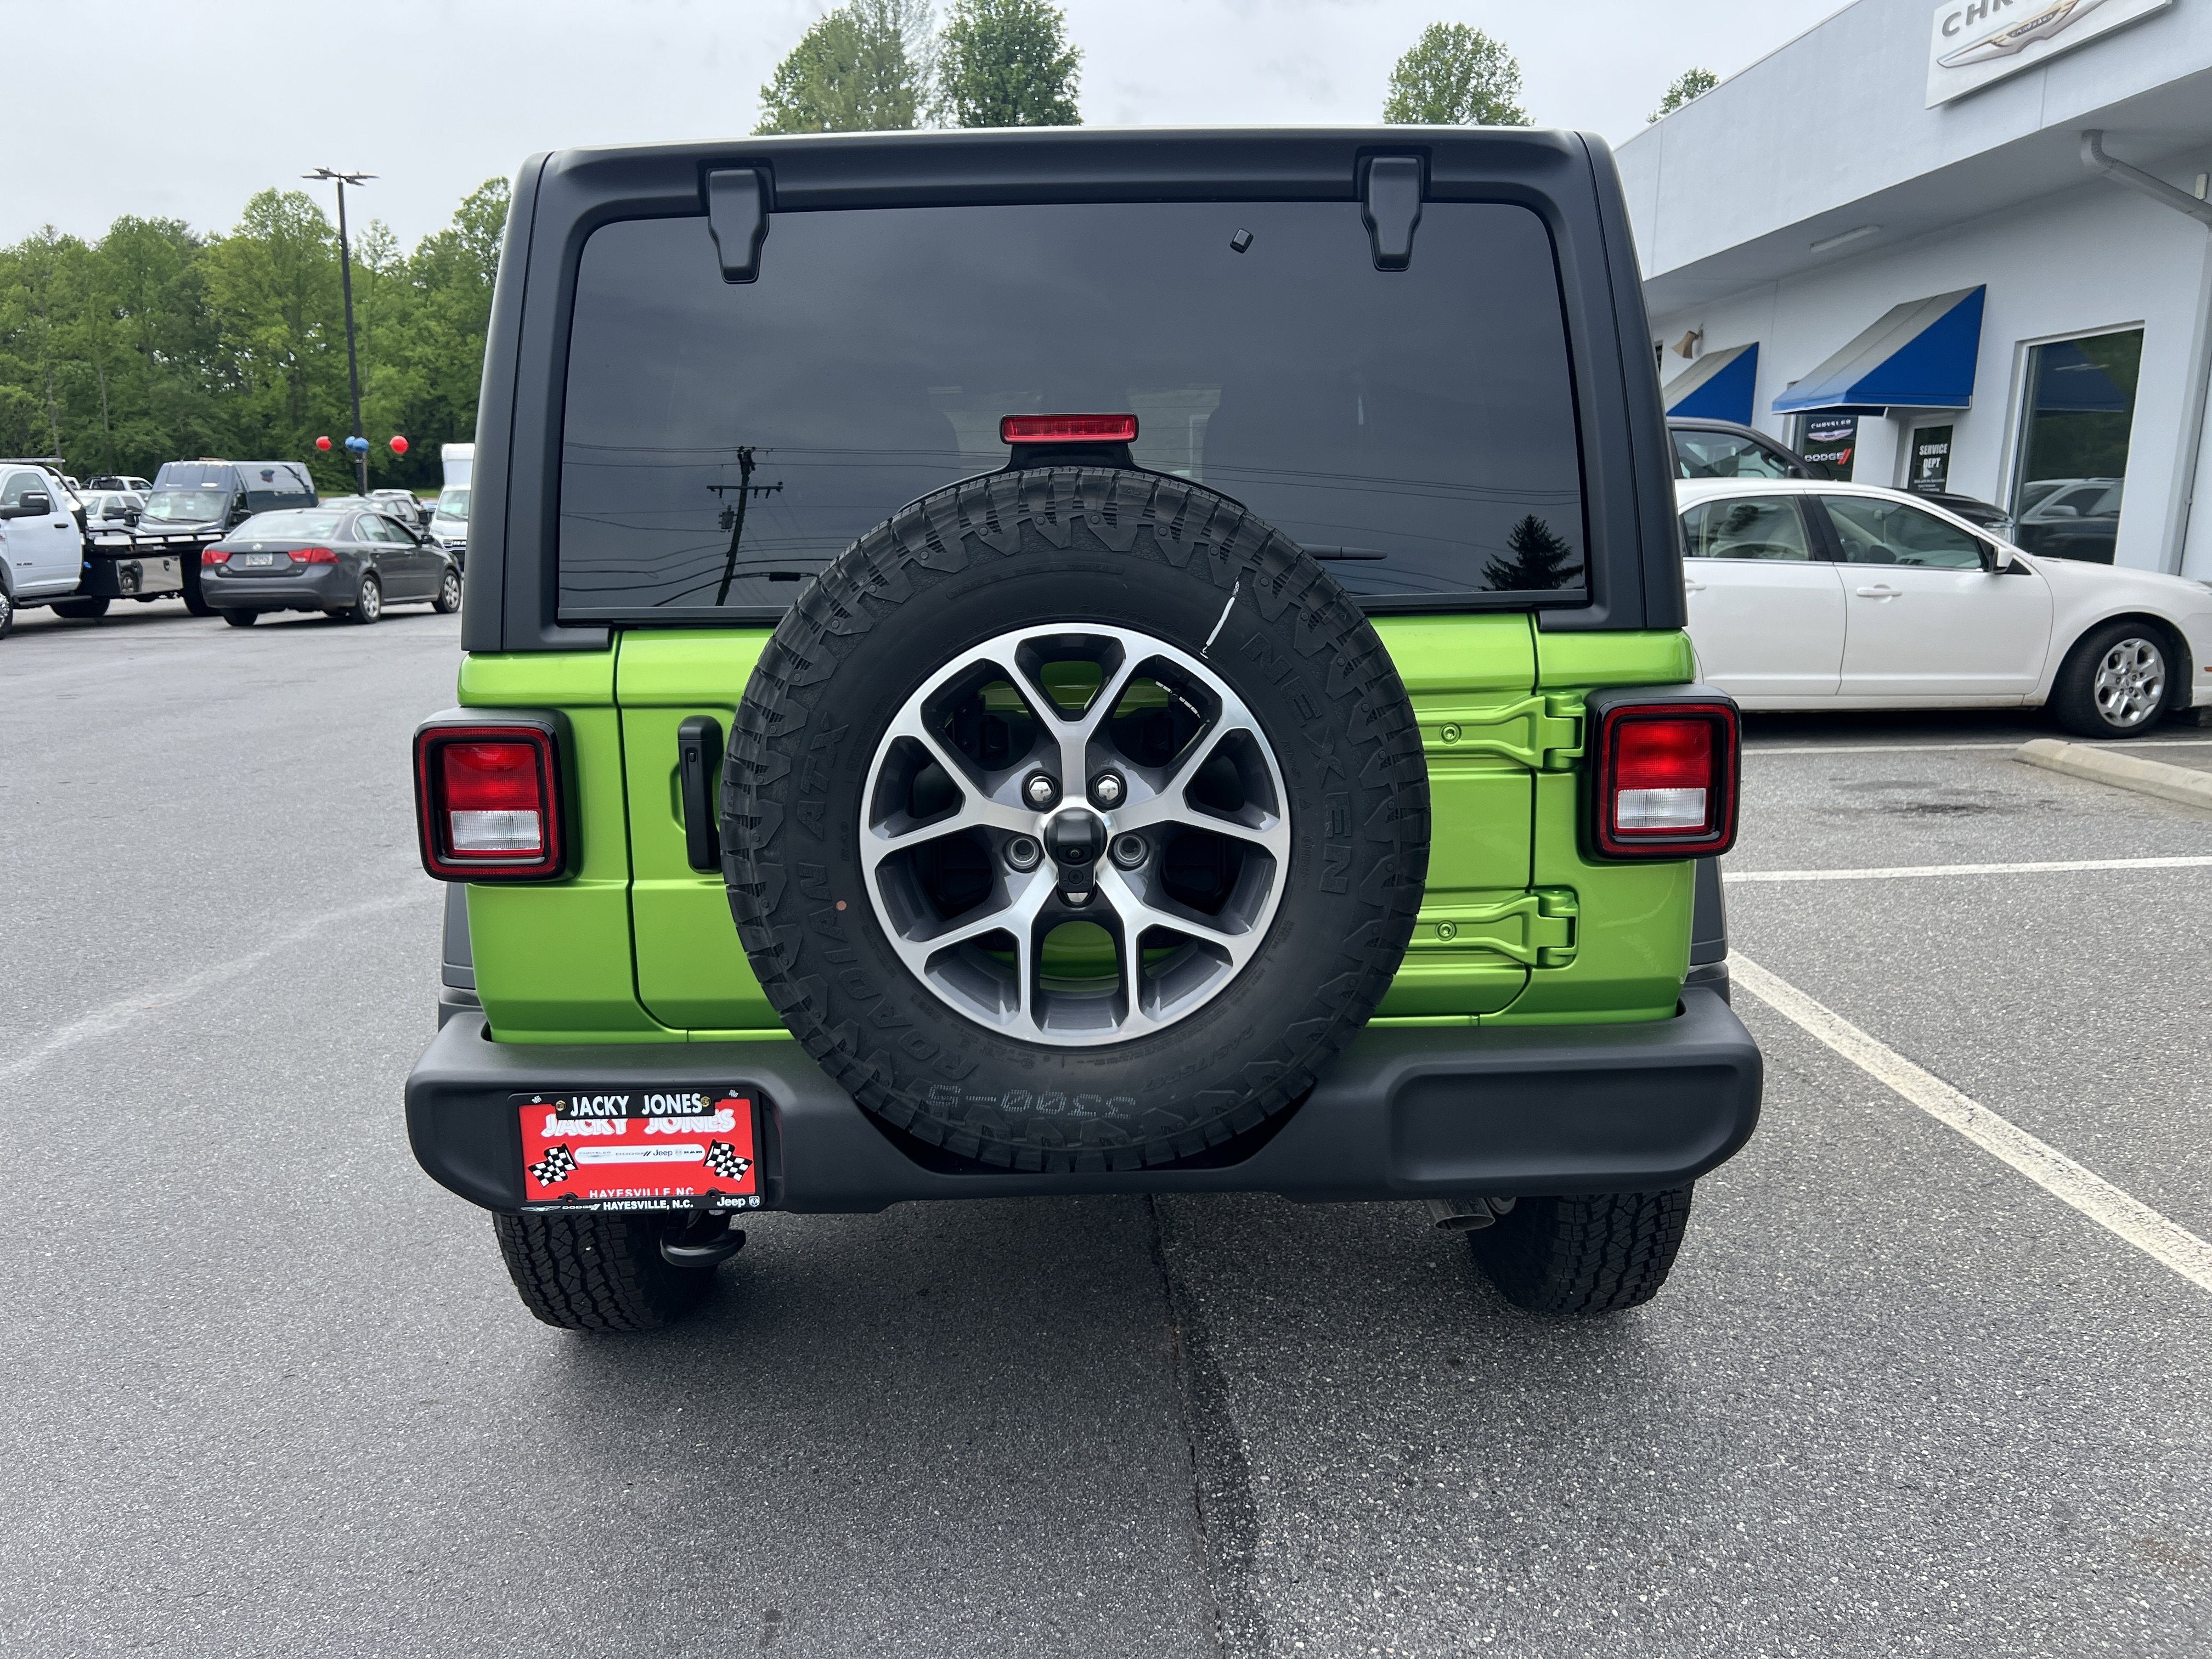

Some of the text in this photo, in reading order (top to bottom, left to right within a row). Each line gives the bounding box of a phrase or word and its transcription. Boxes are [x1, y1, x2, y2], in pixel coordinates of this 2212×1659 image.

[1804, 452, 1845, 462] DODGE
[1919, 443, 1948, 455] SERVICE
[1923, 457, 1941, 468] DEPT
[1240, 631, 1352, 894] NEXEN
[797, 712, 850, 841] ATX
[797, 862, 979, 1082] ROADIAN
[570, 1093, 702, 1117] JACKY JONES
[540, 1109, 736, 1136] JACKY JONES
[603, 1200, 670, 1210] HAYESVILLE,
[672, 1199, 694, 1208] N.C.
[716, 1196, 746, 1207] Jeep
